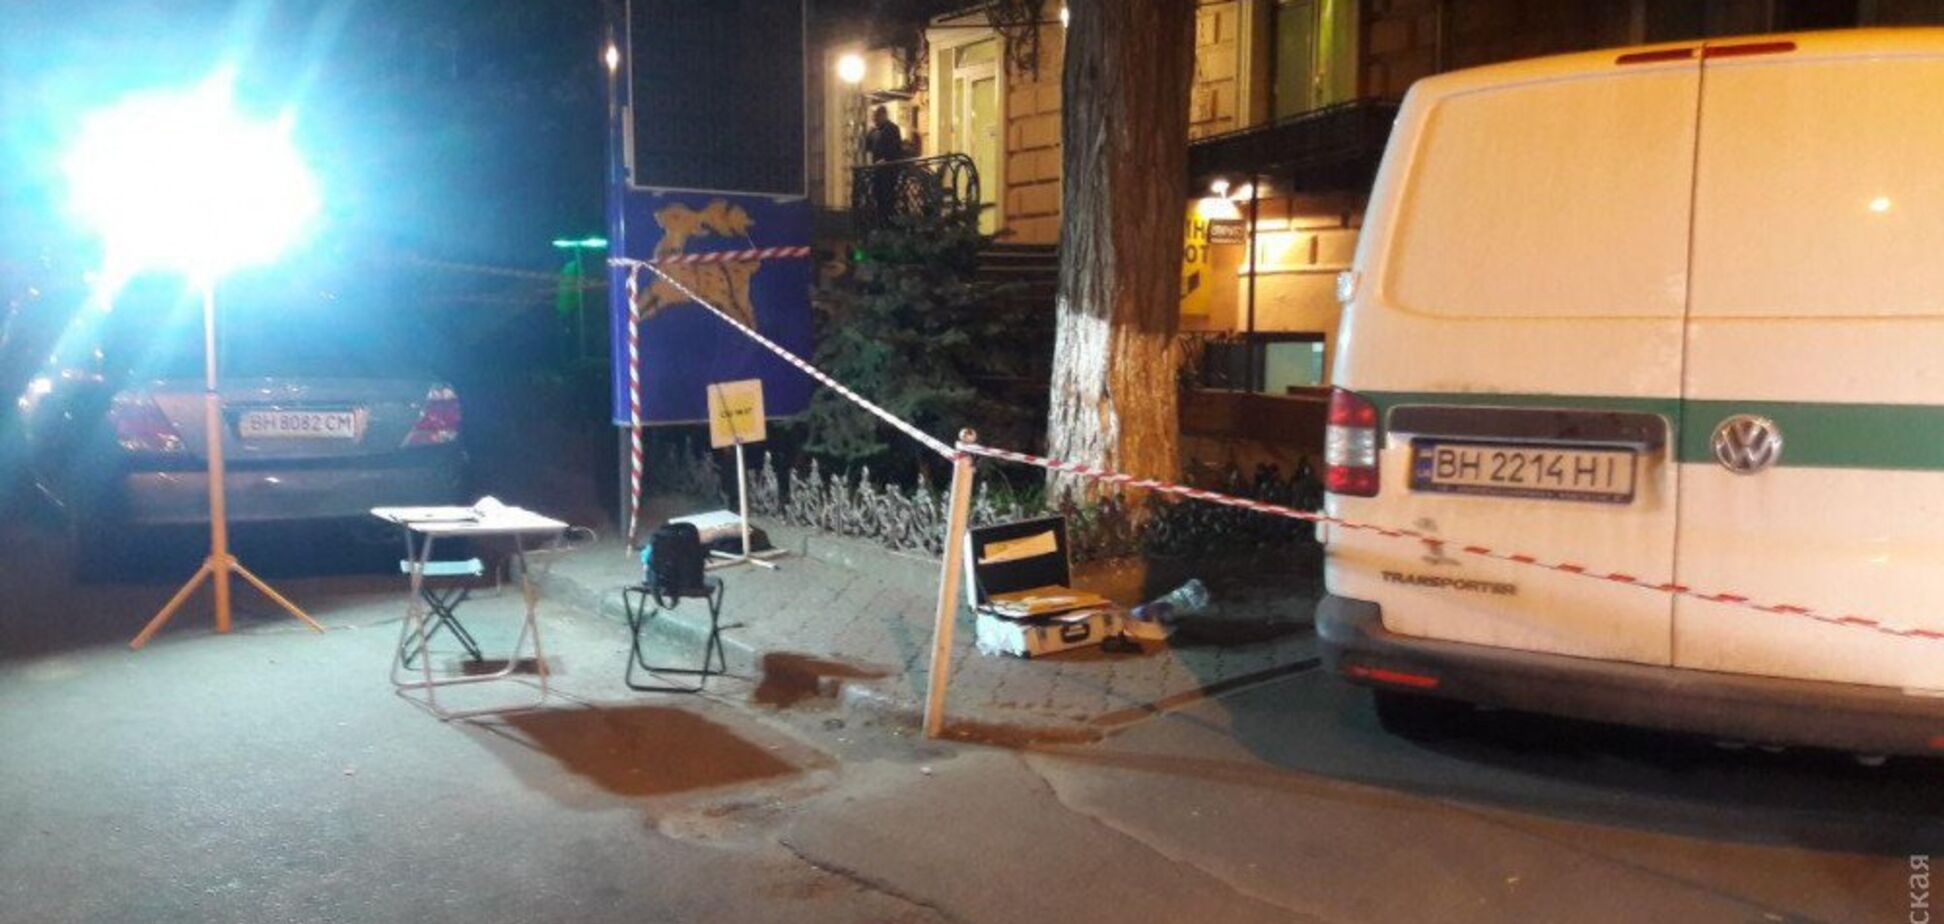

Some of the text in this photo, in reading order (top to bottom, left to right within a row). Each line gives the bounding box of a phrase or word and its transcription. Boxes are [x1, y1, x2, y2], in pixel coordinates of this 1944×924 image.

[1436, 449, 1614, 488] BH 2214 HI
[1381, 570, 1517, 596] TRANSPORTER
